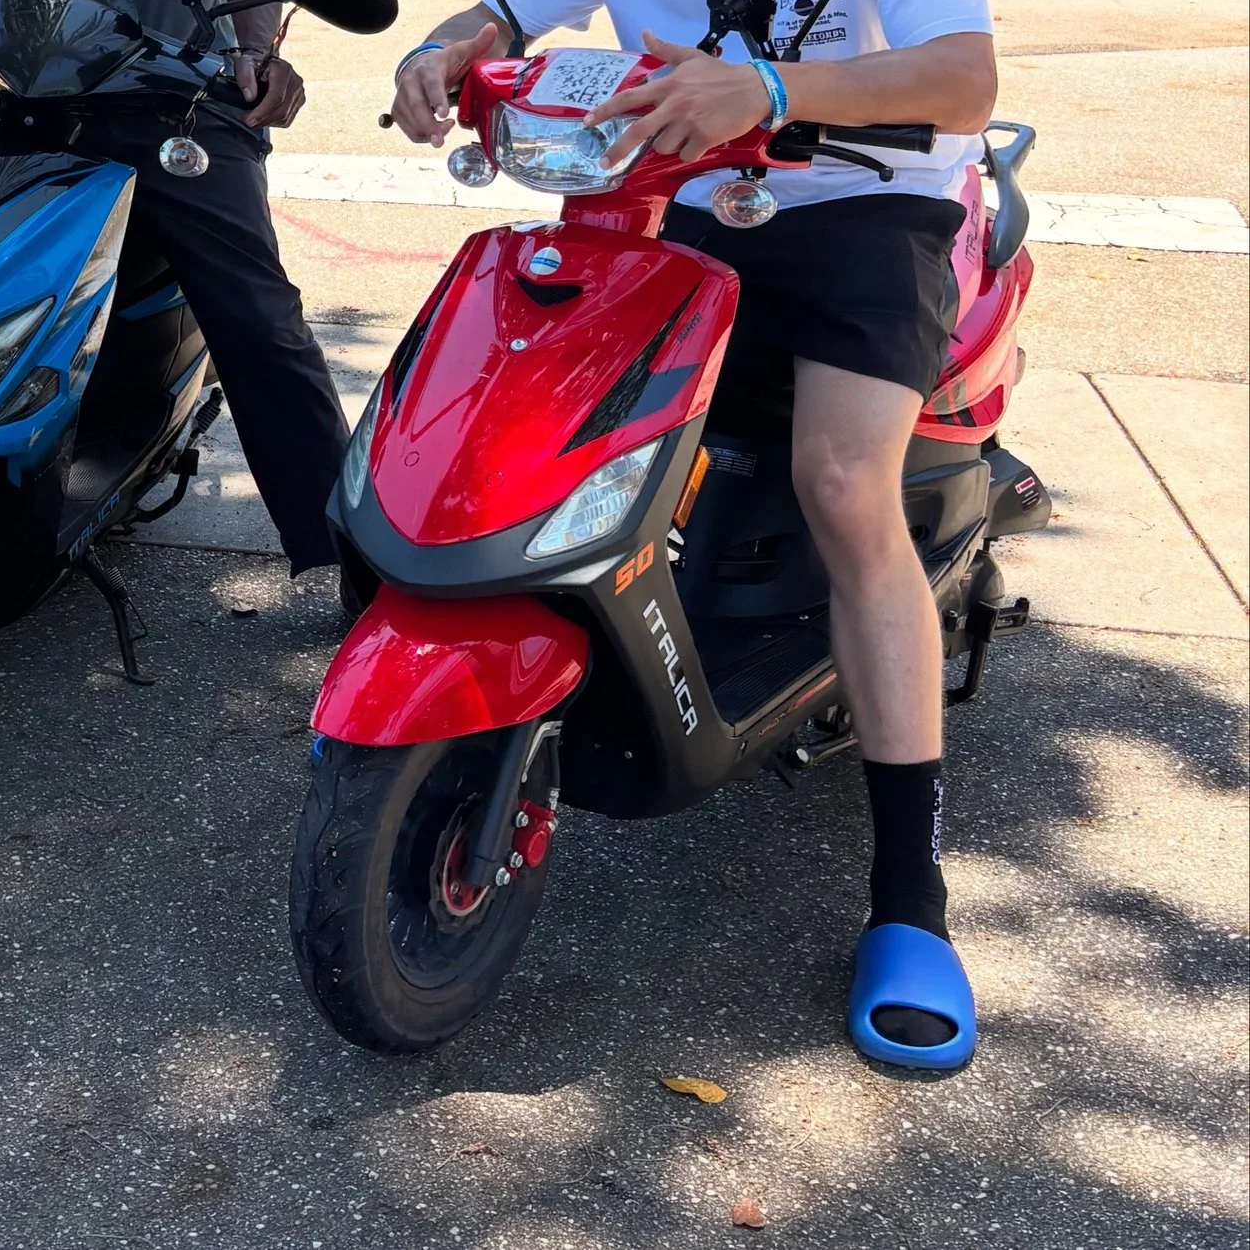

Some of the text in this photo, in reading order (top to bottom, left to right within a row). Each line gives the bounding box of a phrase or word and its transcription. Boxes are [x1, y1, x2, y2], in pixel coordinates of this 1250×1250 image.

[965, 198, 979, 266] ITALICA
[68, 490, 120, 562] ITALICA
[614, 542, 655, 596] 50
[642, 598, 698, 736] ITALICA
